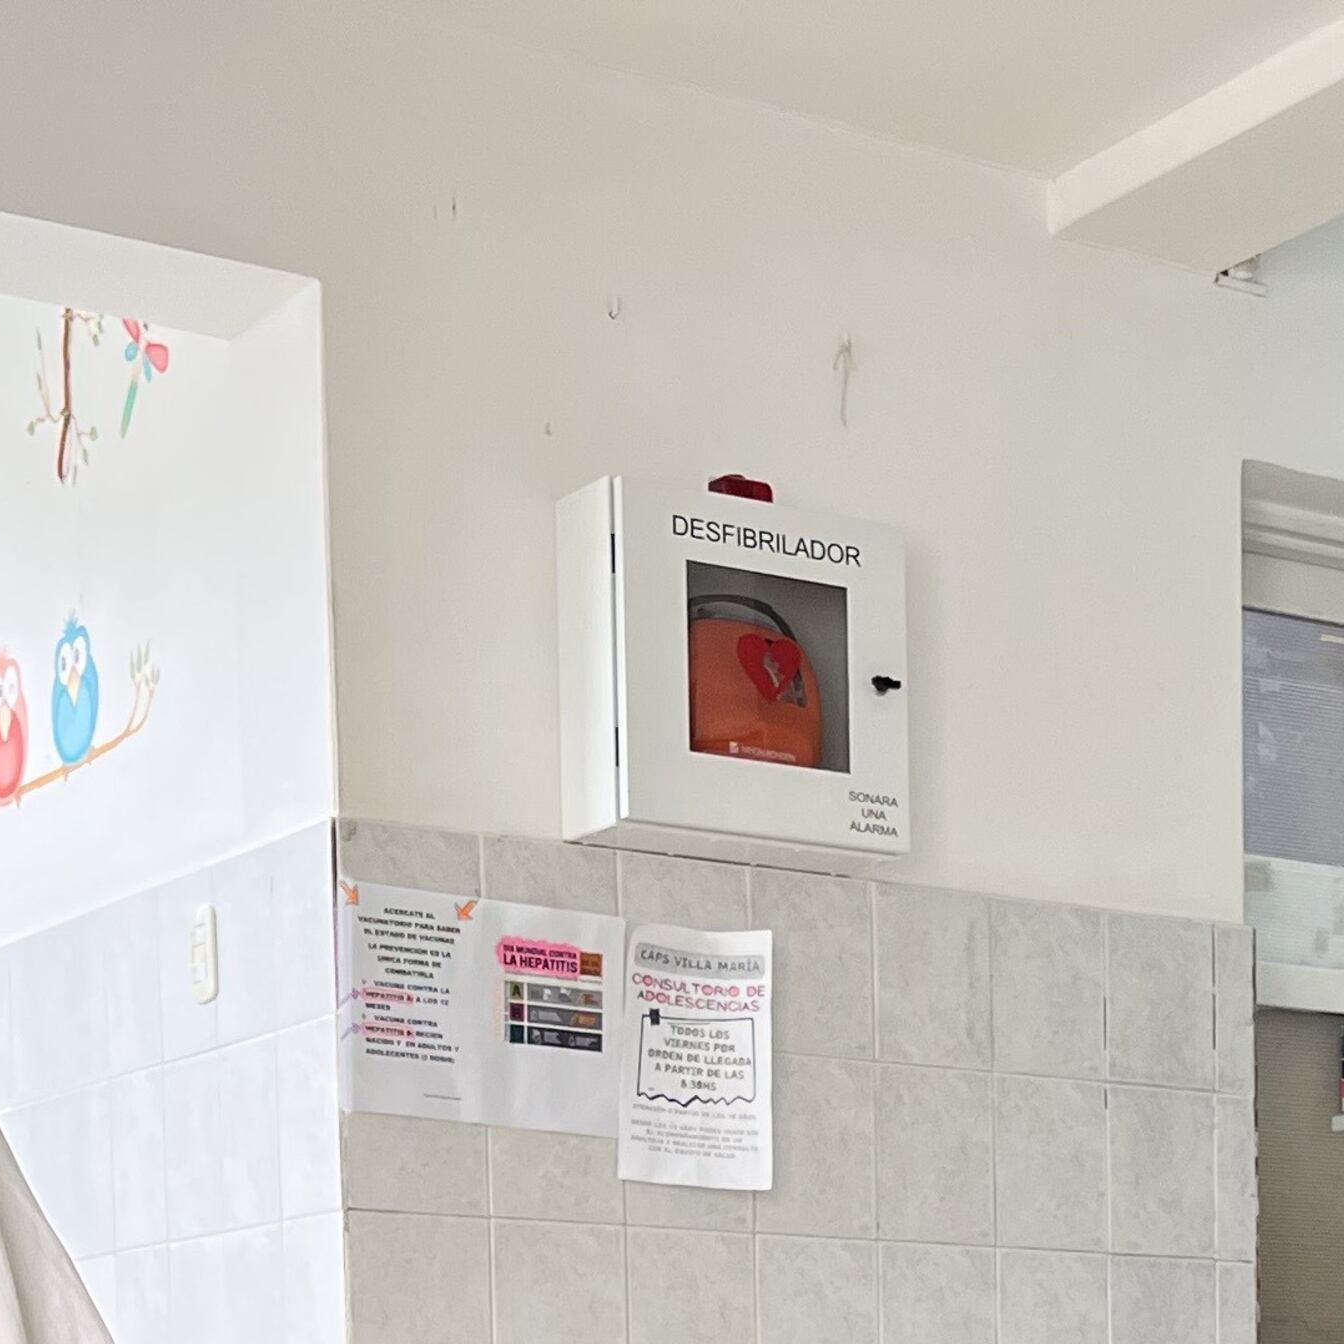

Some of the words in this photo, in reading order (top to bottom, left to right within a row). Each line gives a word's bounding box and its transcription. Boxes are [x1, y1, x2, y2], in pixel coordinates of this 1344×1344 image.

[672, 514, 862, 568] DESFIBRILADOR
[848, 790, 898, 808] SONARA
[862, 808, 887, 821] UNA
[849, 820, 898, 838] ALARMA
[504, 953, 516, 966] LA
[520, 955, 578, 974] HEPATITIS
[640, 950, 670, 964] CAPS
[674, 956, 712, 970] VILLA
[512, 984, 522, 997] A
[632, 972, 740, 998] CONSULTORIO
[746, 984, 766, 997] DE
[637, 990, 760, 1012] ADOLESCENCIAS
[671, 1025, 706, 1038] TODOS
[709, 1030, 730, 1040] LOS
[664, 1038, 710, 1052] VIERNES
[713, 1043, 736, 1052] POR
[648, 1048, 683, 1062] ORDEN
[686, 1054, 701, 1063] DE
[704, 1056, 752, 1066] LLEGADA
[655, 1062, 662, 1072] A
[664, 1063, 704, 1077] PARTIR
[706, 1068, 721, 1078] DE
[724, 1070, 744, 1080] LAS
